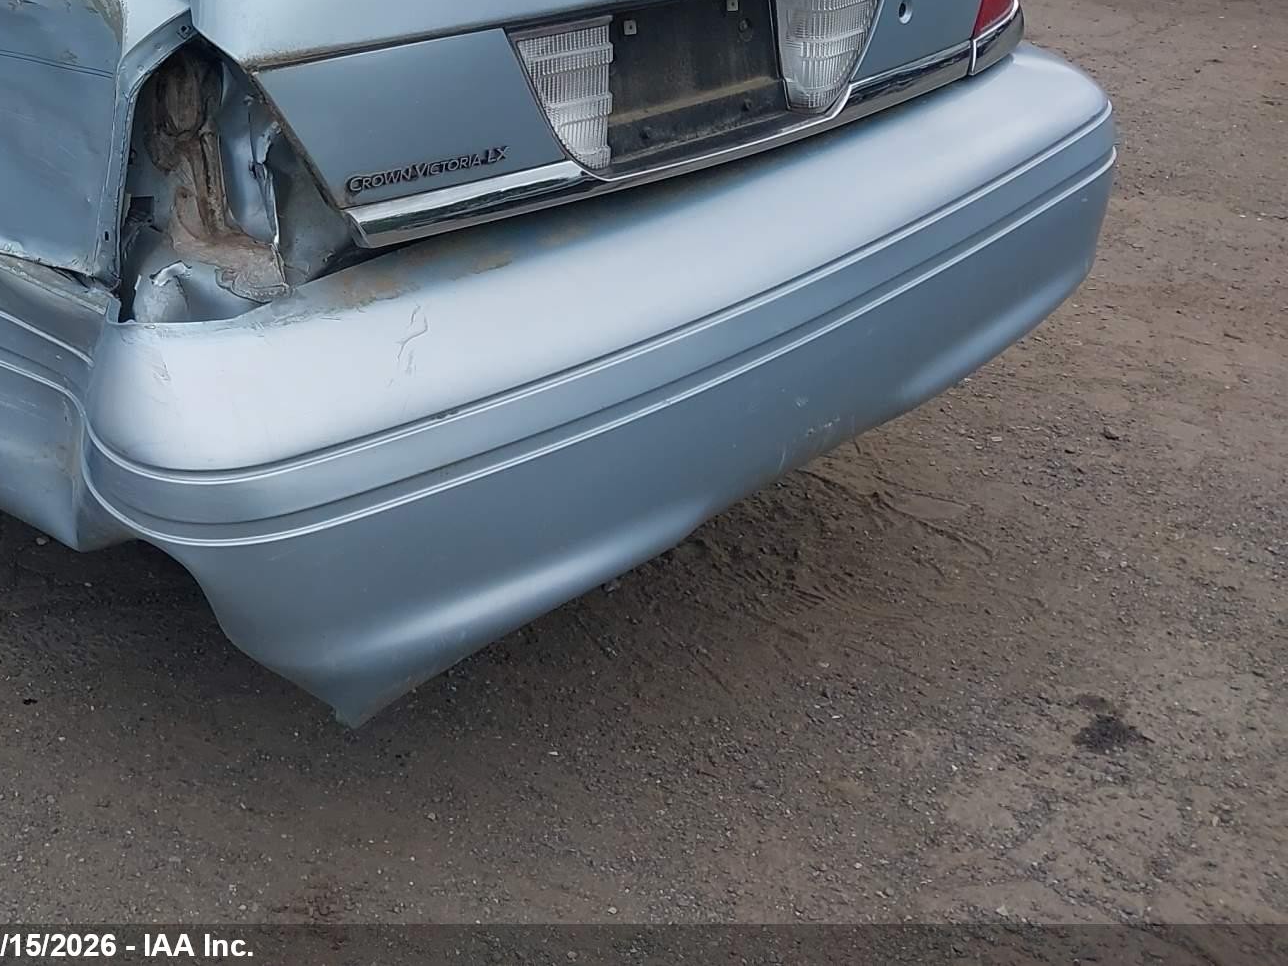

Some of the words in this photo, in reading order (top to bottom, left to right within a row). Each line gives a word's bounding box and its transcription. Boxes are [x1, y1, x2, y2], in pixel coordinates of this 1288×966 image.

[347, 166, 412, 193] CROWN
[412, 152, 482, 179] VICTORIA
[486, 145, 511, 164] LX
